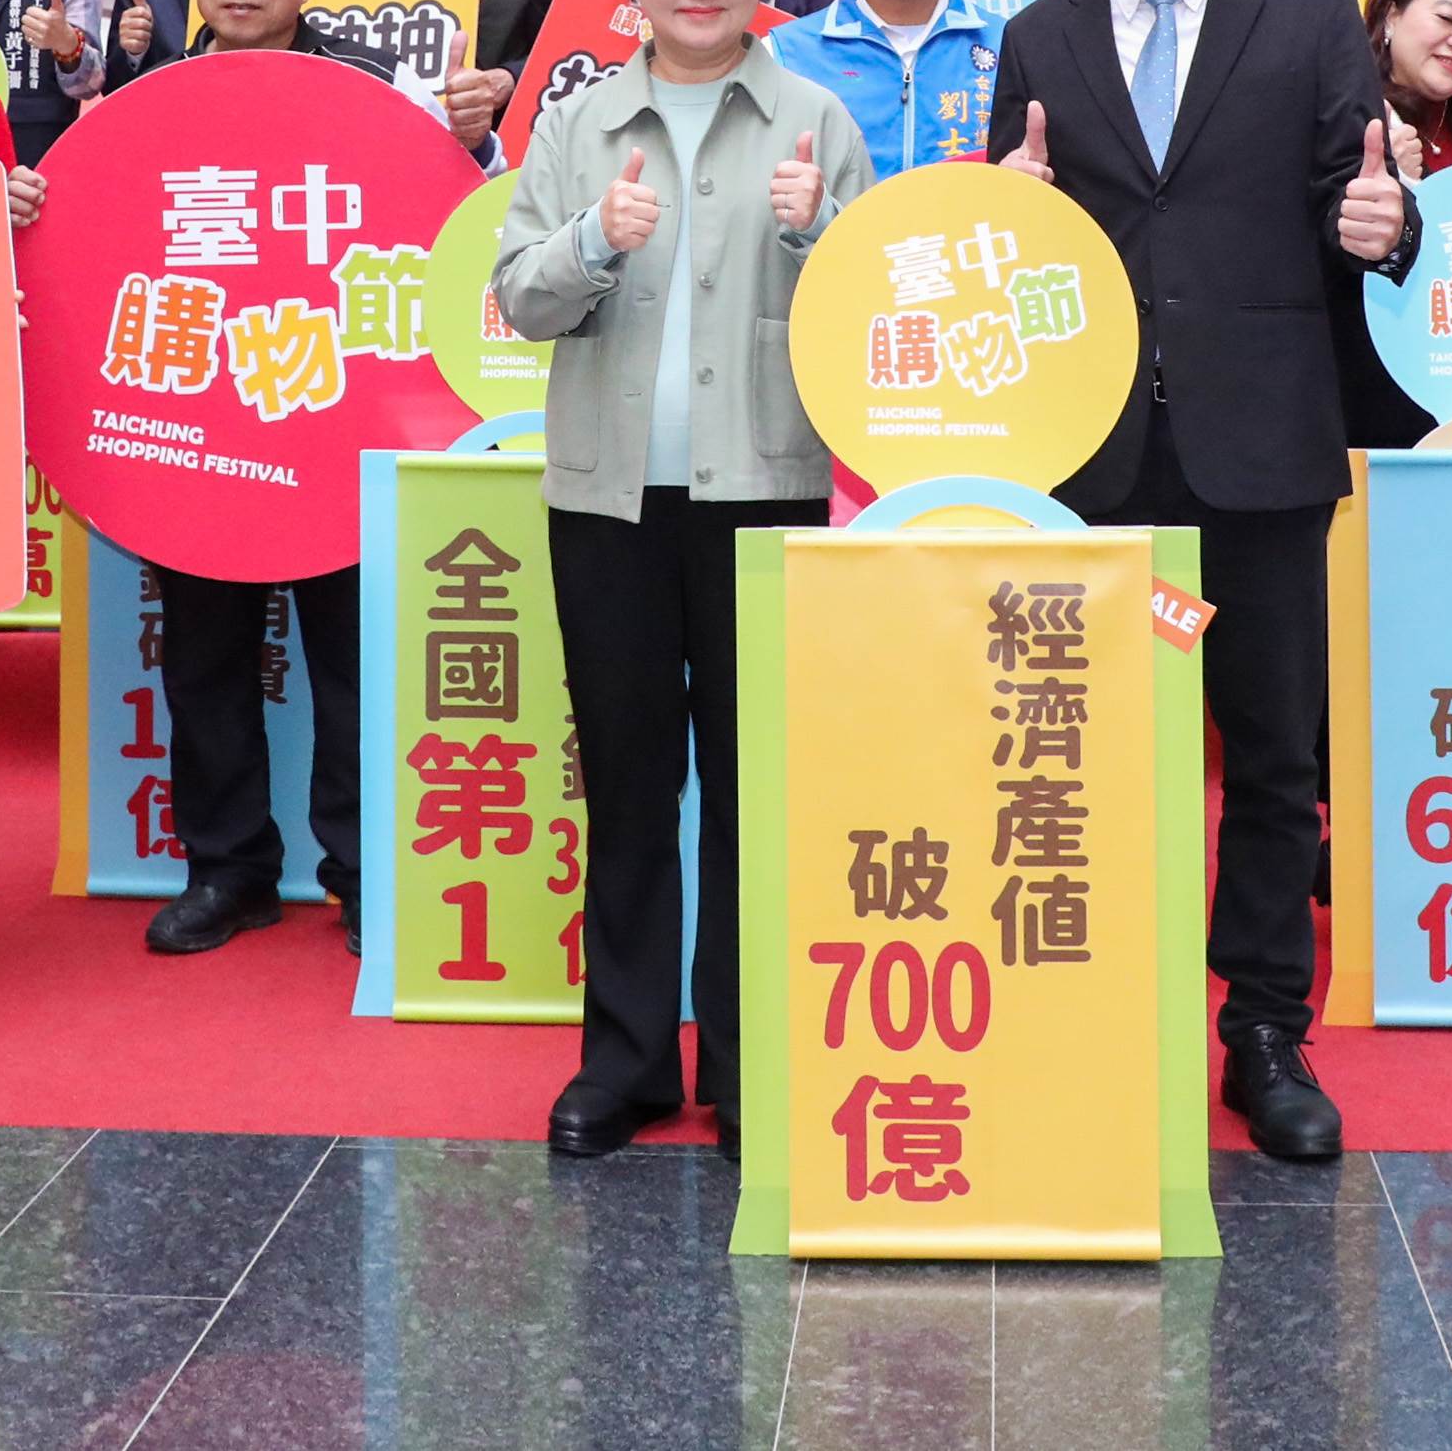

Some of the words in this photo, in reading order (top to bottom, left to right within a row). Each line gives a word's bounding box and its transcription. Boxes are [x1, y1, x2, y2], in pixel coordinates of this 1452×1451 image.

[162, 165, 362, 266] 臺中
[884, 222, 1019, 307] 臺中
[100, 243, 431, 423] 購物節
[866, 263, 1087, 397] 購物節
[480, 355, 537, 367] TAICHUNG
[92, 409, 205, 446] TAICHUNG
[867, 407, 943, 420] TAICHUNG
[867, 424, 942, 436] SHOPPING
[945, 424, 1009, 436] FESTIVAL
[86, 433, 200, 471] SHOPPING
[202, 452, 299, 487] FESTIVAL
[1151, 589, 1202, 636] ALE
[986, 580, 1091, 968] 經濟產值
